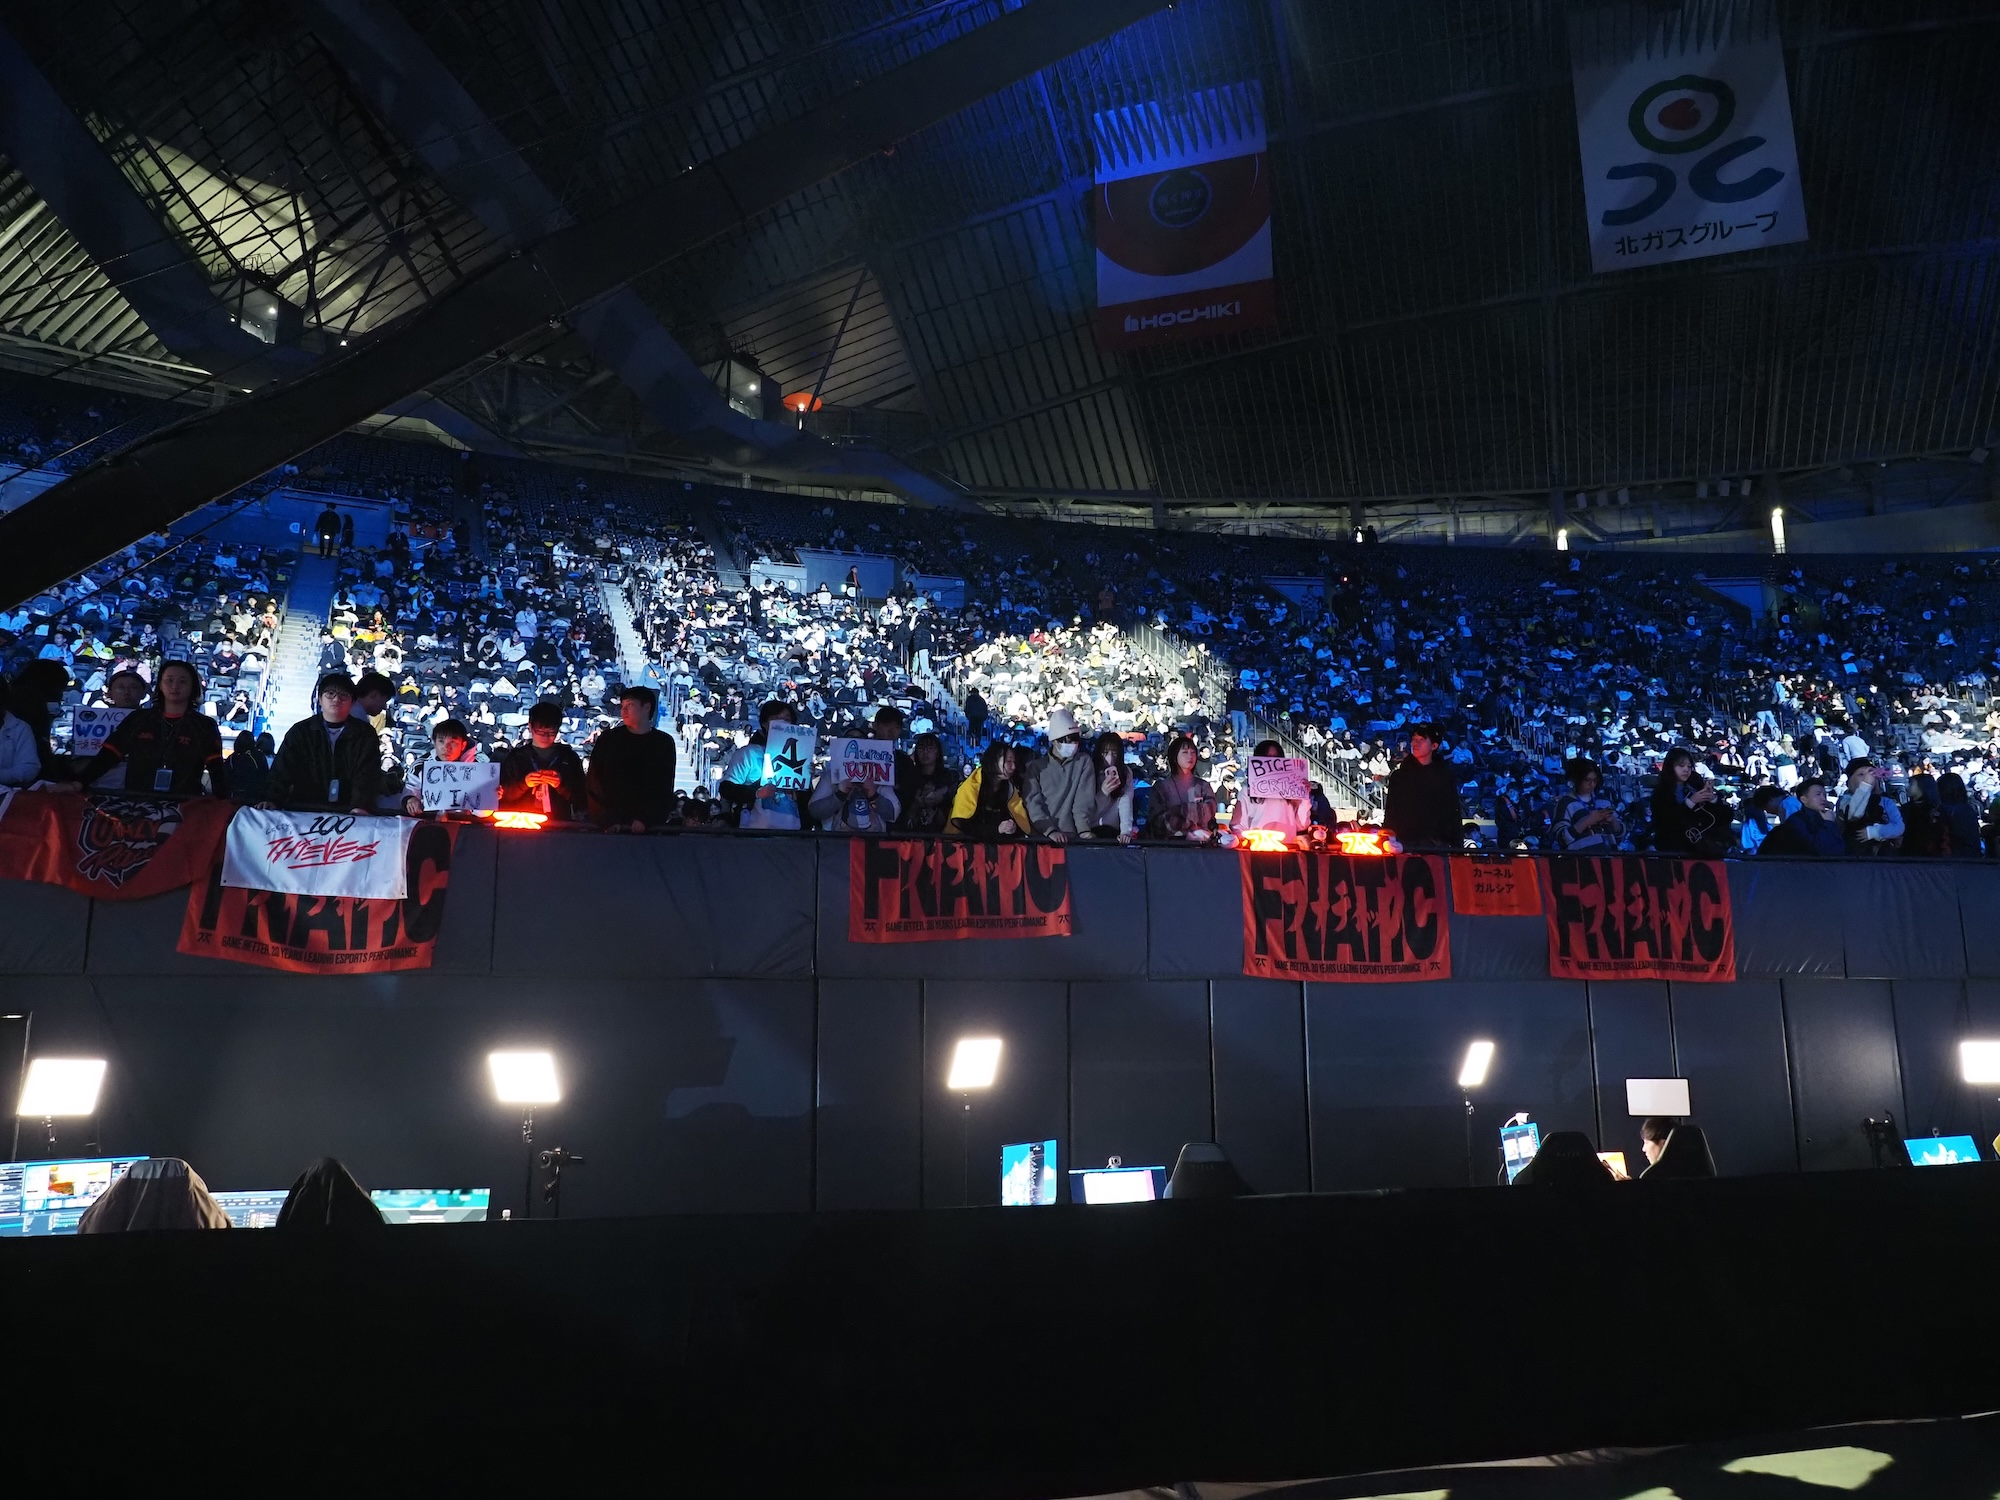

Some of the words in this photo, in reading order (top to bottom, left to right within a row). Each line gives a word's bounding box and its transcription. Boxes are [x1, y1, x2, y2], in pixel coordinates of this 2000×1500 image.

[1615, 211, 1778, 255] 北ガスグループ
[1141, 301, 1241, 330] HOCHIKI
[426, 764, 476, 784] CRT
[843, 761, 892, 782] WIN
[1257, 777, 1290, 793] CRT
[424, 789, 481, 809] WIN
[298, 815, 356, 836] 100
[266, 835, 382, 864] THIEVES
[1473, 867, 1514, 879] カーネル
[1475, 883, 1515, 893] ガルシア
[1251, 853, 1438, 963] FNATIC
[1549, 859, 1725, 962] FNATIC
[1004, 916, 1047, 928] PERFORMANCE
[222, 936, 241, 950] GAME
[281, 947, 302, 961] YEARS
[304, 951, 334, 963] LEADING
[335, 952, 367, 964] ESPORTS
[369, 947, 418, 961] PERFORMANCE
[1320, 963, 1337, 973] YEARS
[1359, 964, 1384, 974] ESPORTS
